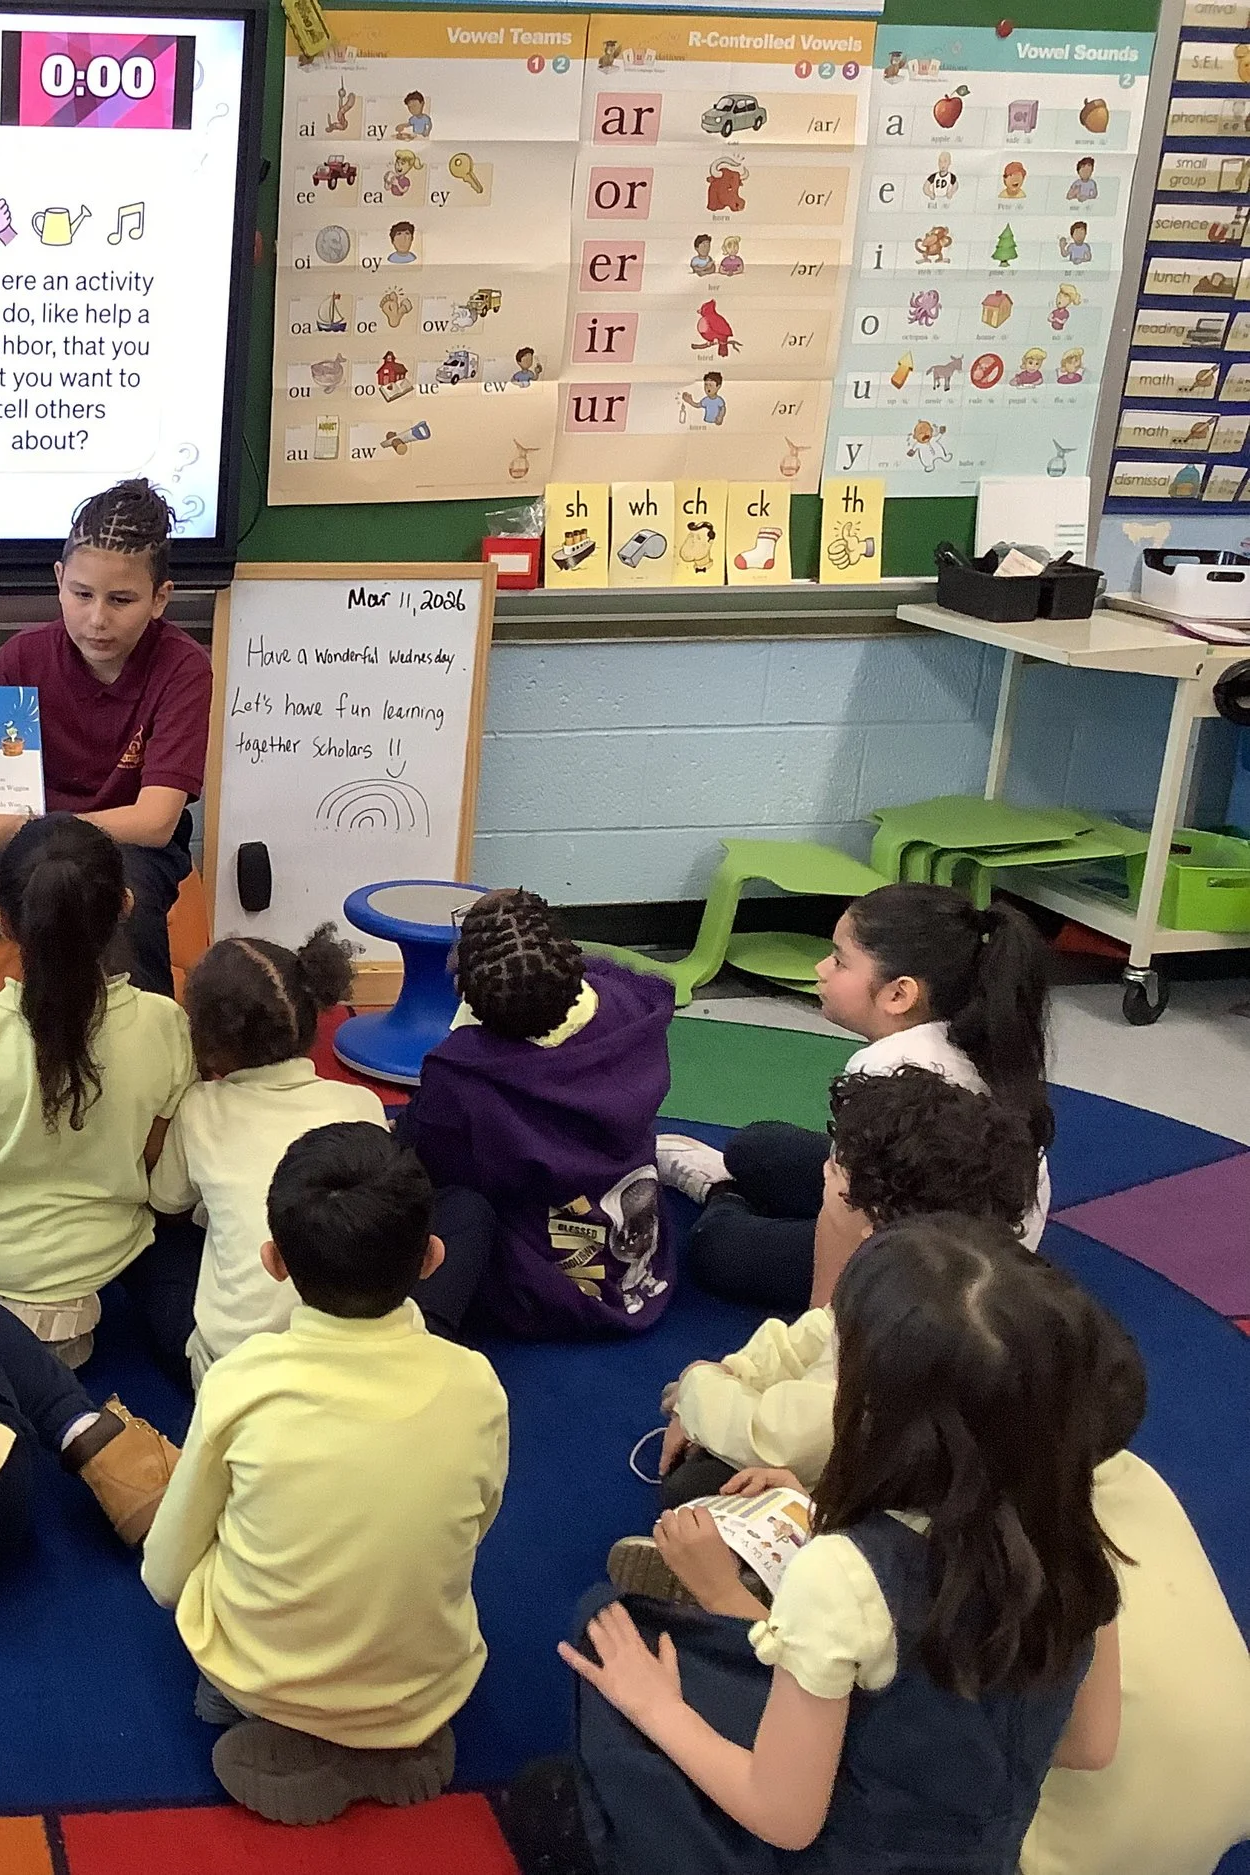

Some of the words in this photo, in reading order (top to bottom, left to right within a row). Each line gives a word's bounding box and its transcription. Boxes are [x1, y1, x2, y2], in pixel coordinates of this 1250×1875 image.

[1195, 2, 1236, 15] arrival
[447, 27, 504, 44] Vowel
[510, 28, 572, 45] Teams
[689, 31, 795, 50] R-Controlled
[801, 34, 862, 52] Vowels
[1017, 43, 1069, 60] Vowel
[1074, 45, 1139, 62] Sounds
[40, 53, 155, 99] 0:00
[601, 105, 654, 135] ar
[807, 117, 840, 134] /ar/
[886, 114, 904, 136] a
[1172, 112, 1218, 125] phonics
[299, 122, 316, 137] ai
[367, 123, 388, 141] ay
[1177, 158, 1207, 169] small
[936, 178, 947, 189] ED
[1170, 174, 1206, 188] group
[297, 190, 316, 204] ee
[363, 190, 383, 204] ea
[430, 190, 450, 207] ey
[595, 180, 647, 210] or
[797, 190, 832, 207] /or/
[879, 183, 895, 203] e
[1155, 217, 1209, 231] science
[294, 255, 311, 270] oi
[361, 256, 382, 272] oy
[873, 244, 883, 270] i
[589, 253, 637, 282] er
[43, 274, 69, 291] an
[75, 269, 154, 296] activity
[1153, 270, 1190, 284] lunch
[2, 301, 35, 326] do,
[42, 302, 78, 324] like
[86, 303, 131, 328] help
[137, 308, 150, 325] a
[291, 321, 312, 335] oa
[356, 320, 377, 333] oe
[423, 319, 449, 332] ow
[861, 315, 879, 336] o
[1138, 322, 1185, 337] reading
[585, 318, 625, 353] ir
[63, 335, 105, 356] that
[111, 340, 150, 361] you
[13, 371, 52, 392] you
[59, 369, 112, 387] want
[119, 368, 140, 387] to
[419, 382, 439, 395] ue
[483, 381, 507, 393] ew
[1140, 374, 1175, 387] math
[289, 385, 311, 398] ou
[354, 385, 375, 396] oo
[854, 380, 871, 399] u
[35, 399, 106, 420] others
[572, 395, 625, 423] ur
[1133, 425, 1169, 438] math
[11, 431, 89, 451] about?
[286, 448, 308, 461] au
[351, 447, 376, 460] aw
[843, 443, 863, 470] y
[1114, 473, 1170, 488] dismissal
[566, 490, 588, 517] sh
[629, 489, 657, 516] wh
[683, 487, 707, 515] ch
[747, 490, 769, 517] ck
[842, 486, 864, 513] th
[348, 587, 391, 609] Mar
[247, 635, 291, 668] Have
[231, 687, 272, 716] Let's
[285, 694, 322, 716] have
[336, 692, 371, 718] fun
[383, 699, 444, 731] learning
[235, 733, 300, 763] together
[558, 1223, 598, 1239] BLESSED
